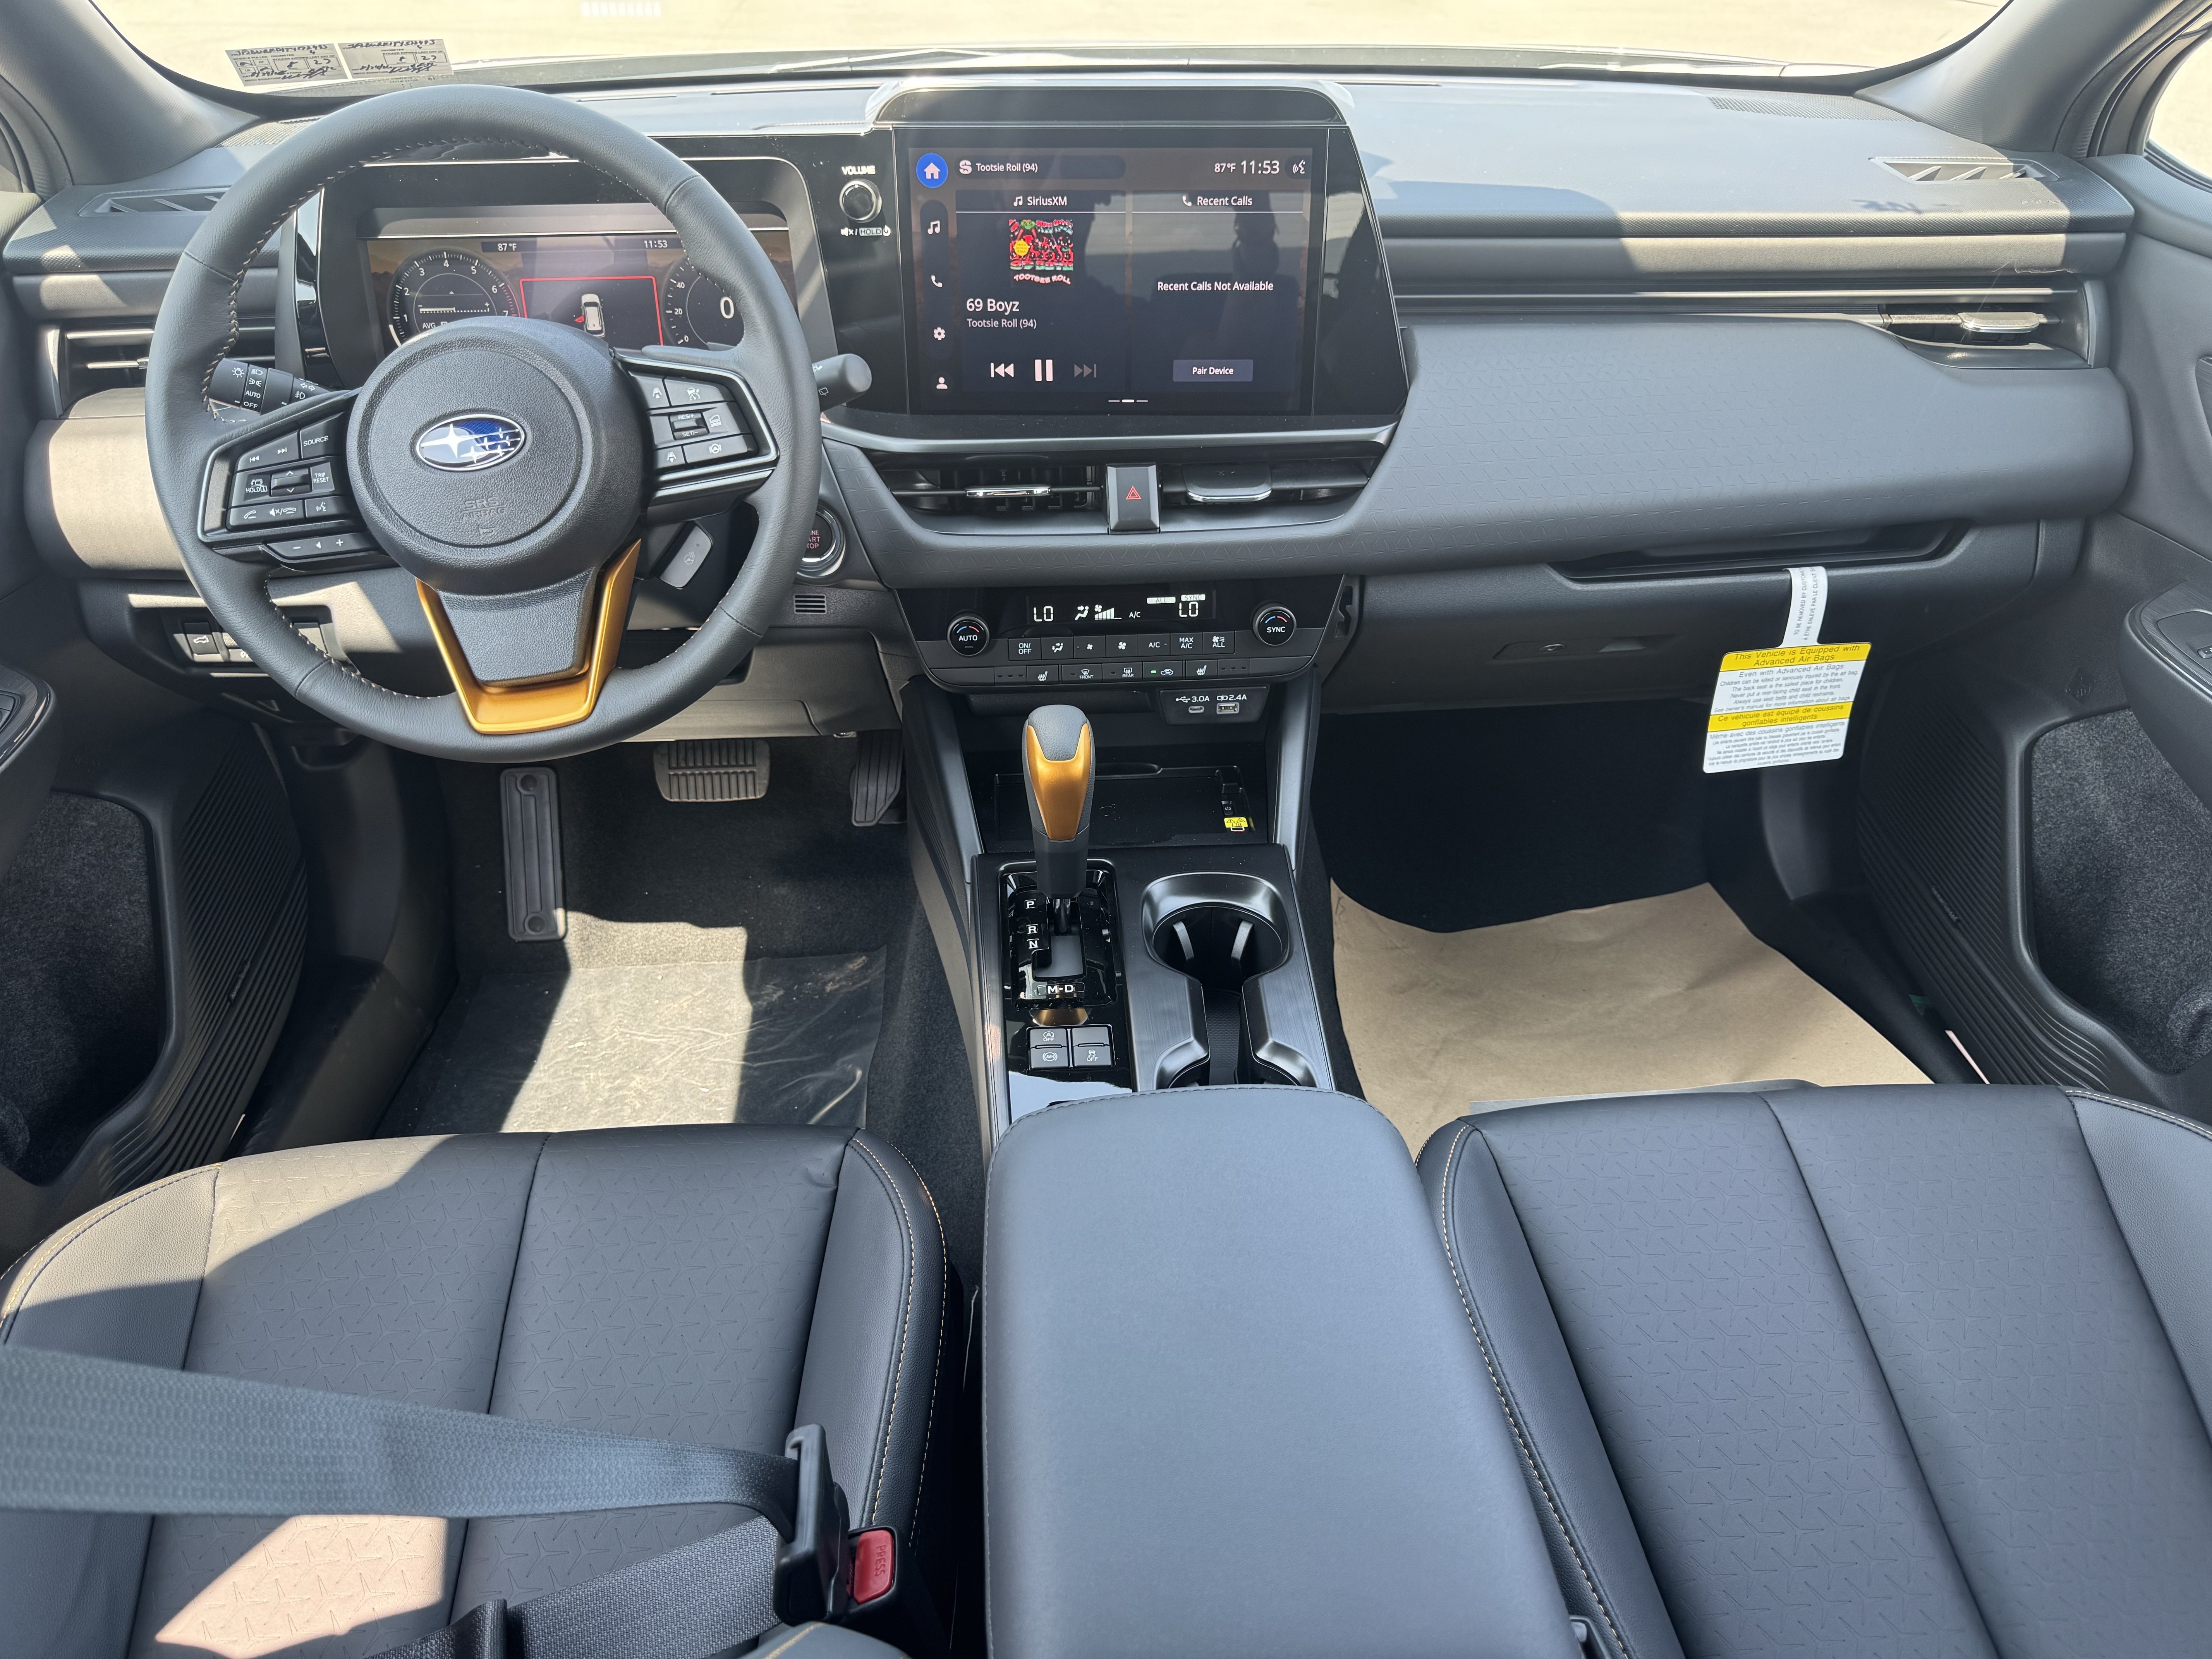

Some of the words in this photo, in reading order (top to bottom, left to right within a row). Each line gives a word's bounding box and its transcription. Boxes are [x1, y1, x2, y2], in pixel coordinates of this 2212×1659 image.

[842, 165, 876, 175] VOLUME
[975, 163, 1004, 172] Tootsie
[1006, 163, 1021, 172] Roll
[1023, 163, 1038, 173] (94)
[1214, 163, 1236, 173] 87°F
[1241, 160, 1279, 174] 11:53
[1027, 196, 1067, 206] SiriusXM
[1197, 196, 1229, 206] Recent
[1231, 196, 1252, 206] Calls
[498, 243, 517, 251] 87°F
[644, 240, 668, 248] 11:53
[443, 259, 450, 268] 4
[420, 268, 425, 276] 3
[471, 266, 477, 274] 5
[1051, 275, 1071, 285] ROLL
[404, 287, 410, 295] 2
[492, 285, 498, 294] 6
[1158, 282, 1189, 291] Recent
[1190, 281, 1212, 291] Calls
[1214, 281, 1231, 291] Not
[1233, 281, 1274, 291] Available
[720, 296, 734, 319] 0
[967, 298, 983, 311] 69
[988, 299, 1020, 315] Boyz
[967, 319, 999, 327] Tootsie
[1001, 318, 1017, 328] Roll
[1020, 319, 1037, 329] (94)
[1192, 367, 1207, 375] Pair
[1209, 367, 1233, 375] Device
[245, 390, 261, 399] AUTO
[303, 435, 329, 447] SOURCE
[465, 497, 499, 509] SRS
[1033, 606, 1054, 622] LO
[1178, 601, 1199, 617] LO
[1797, 600, 1805, 621] REMOVED
[1800, 646, 1840, 654] Equipped
[1753, 656, 1795, 666] Advanced
[1742, 718, 1778, 727] gonflables
[1780, 714, 1817, 722] intelligents
[1028, 926, 1037, 934] R
[875, 1545, 886, 1577] PRESS
